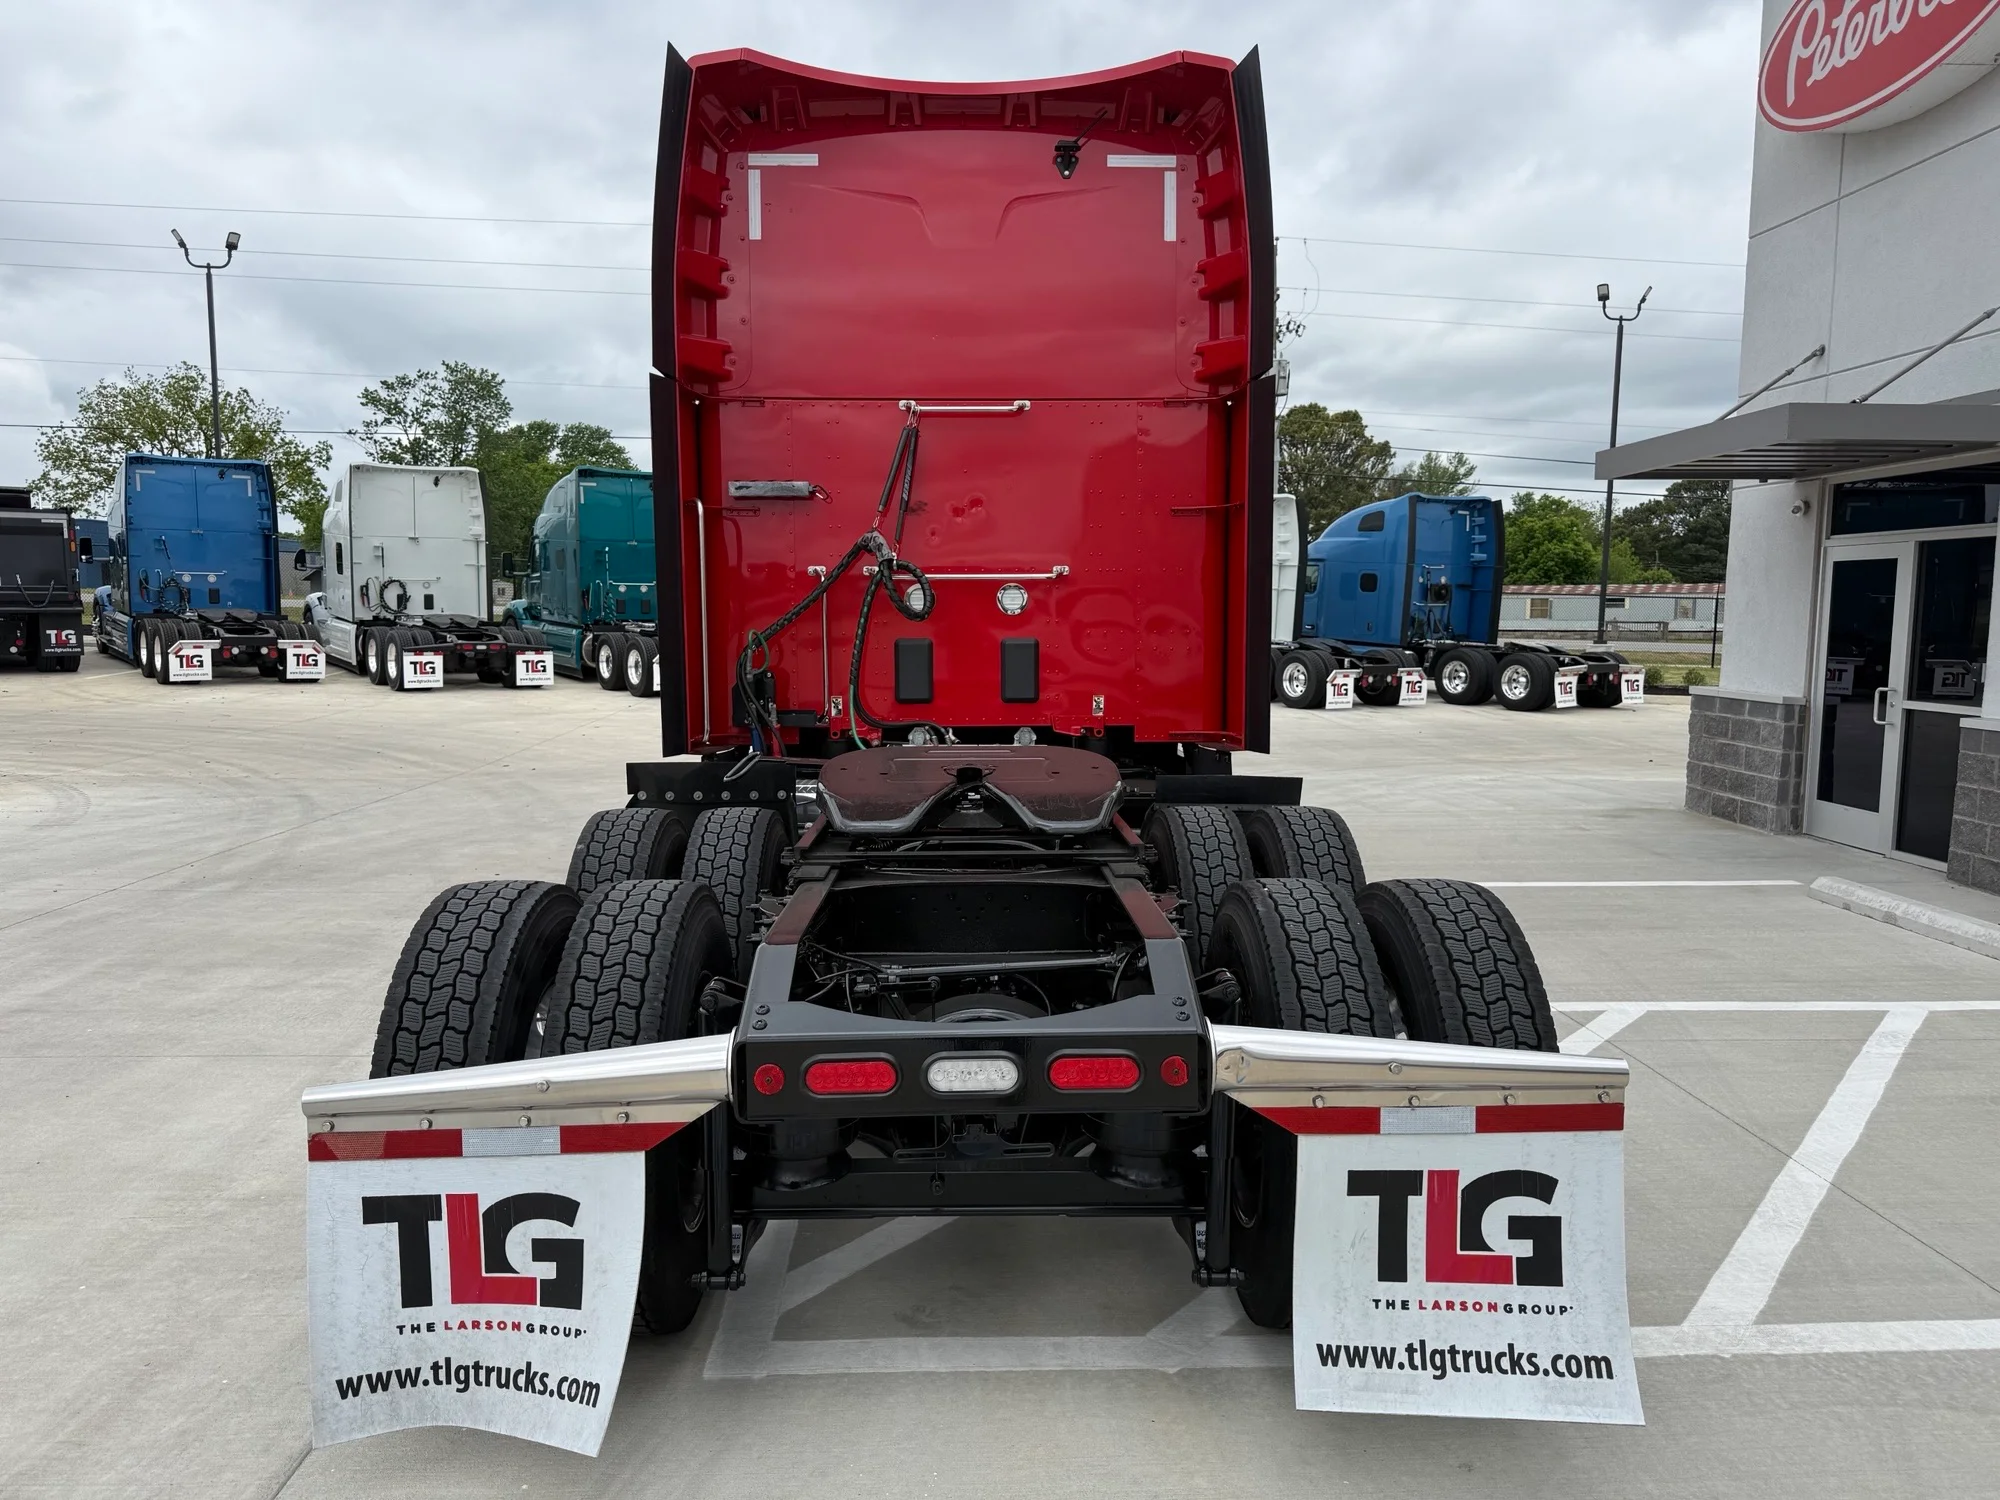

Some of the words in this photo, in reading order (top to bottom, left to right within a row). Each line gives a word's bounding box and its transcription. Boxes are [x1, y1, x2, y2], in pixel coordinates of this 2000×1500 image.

[46, 629, 77, 644] TLG
[175, 654, 204, 669] TLG
[292, 653, 318, 667] TLG
[522, 659, 547, 673] TLG
[409, 661, 435, 675] TLG
[1331, 683, 1348, 697] TLG
[1405, 680, 1423, 694] TLG
[1557, 681, 1573, 695] TLG
[1624, 679, 1640, 692] TLG
[1346, 1169, 1564, 1287] TLG
[361, 1192, 585, 1310] TLG
[1372, 1298, 1410, 1311] THE
[1418, 1299, 1498, 1313] LARSON
[1503, 1302, 1569, 1316] GROUP
[396, 1321, 436, 1336] THE
[444, 1319, 522, 1332] LARSON
[526, 1322, 583, 1339] GROUP
[1315, 1339, 1614, 1381] www.tlgtrucks.com
[335, 1356, 600, 1409] www.tlgtrucks.com
